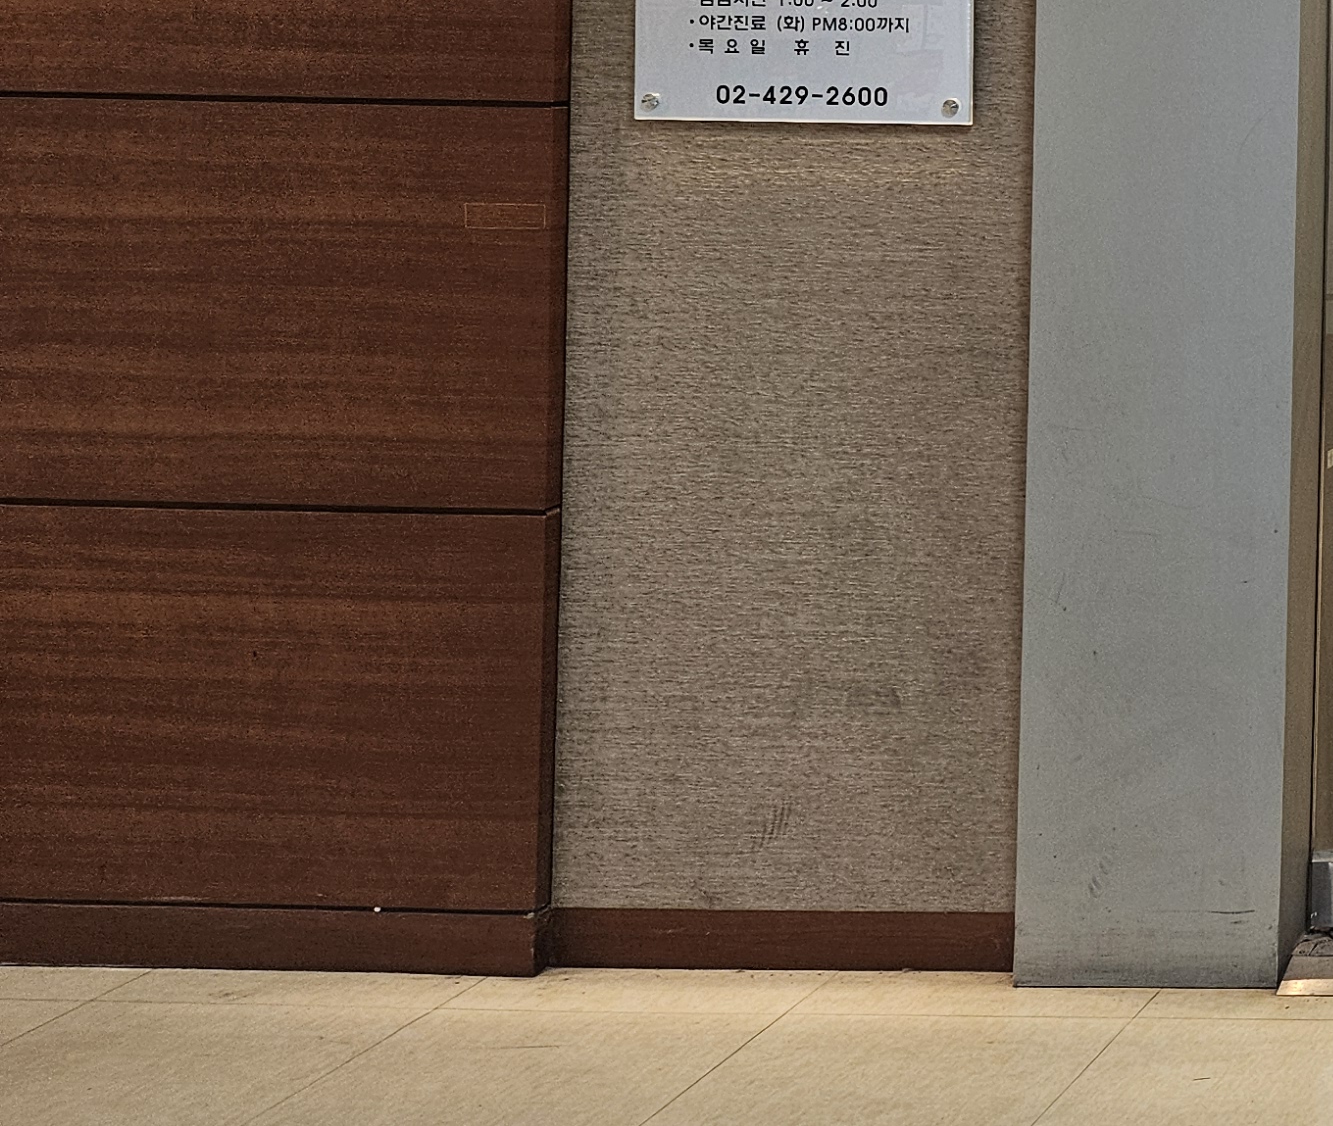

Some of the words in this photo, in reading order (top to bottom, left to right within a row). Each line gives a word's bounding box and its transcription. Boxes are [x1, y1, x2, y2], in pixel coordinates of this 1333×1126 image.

[699, 14, 767, 32] 야간진료
[777, 15, 805, 33] (화)
[812, 16, 910, 33] PM8:00까지
[716, 85, 889, 107] 02-429-2600
